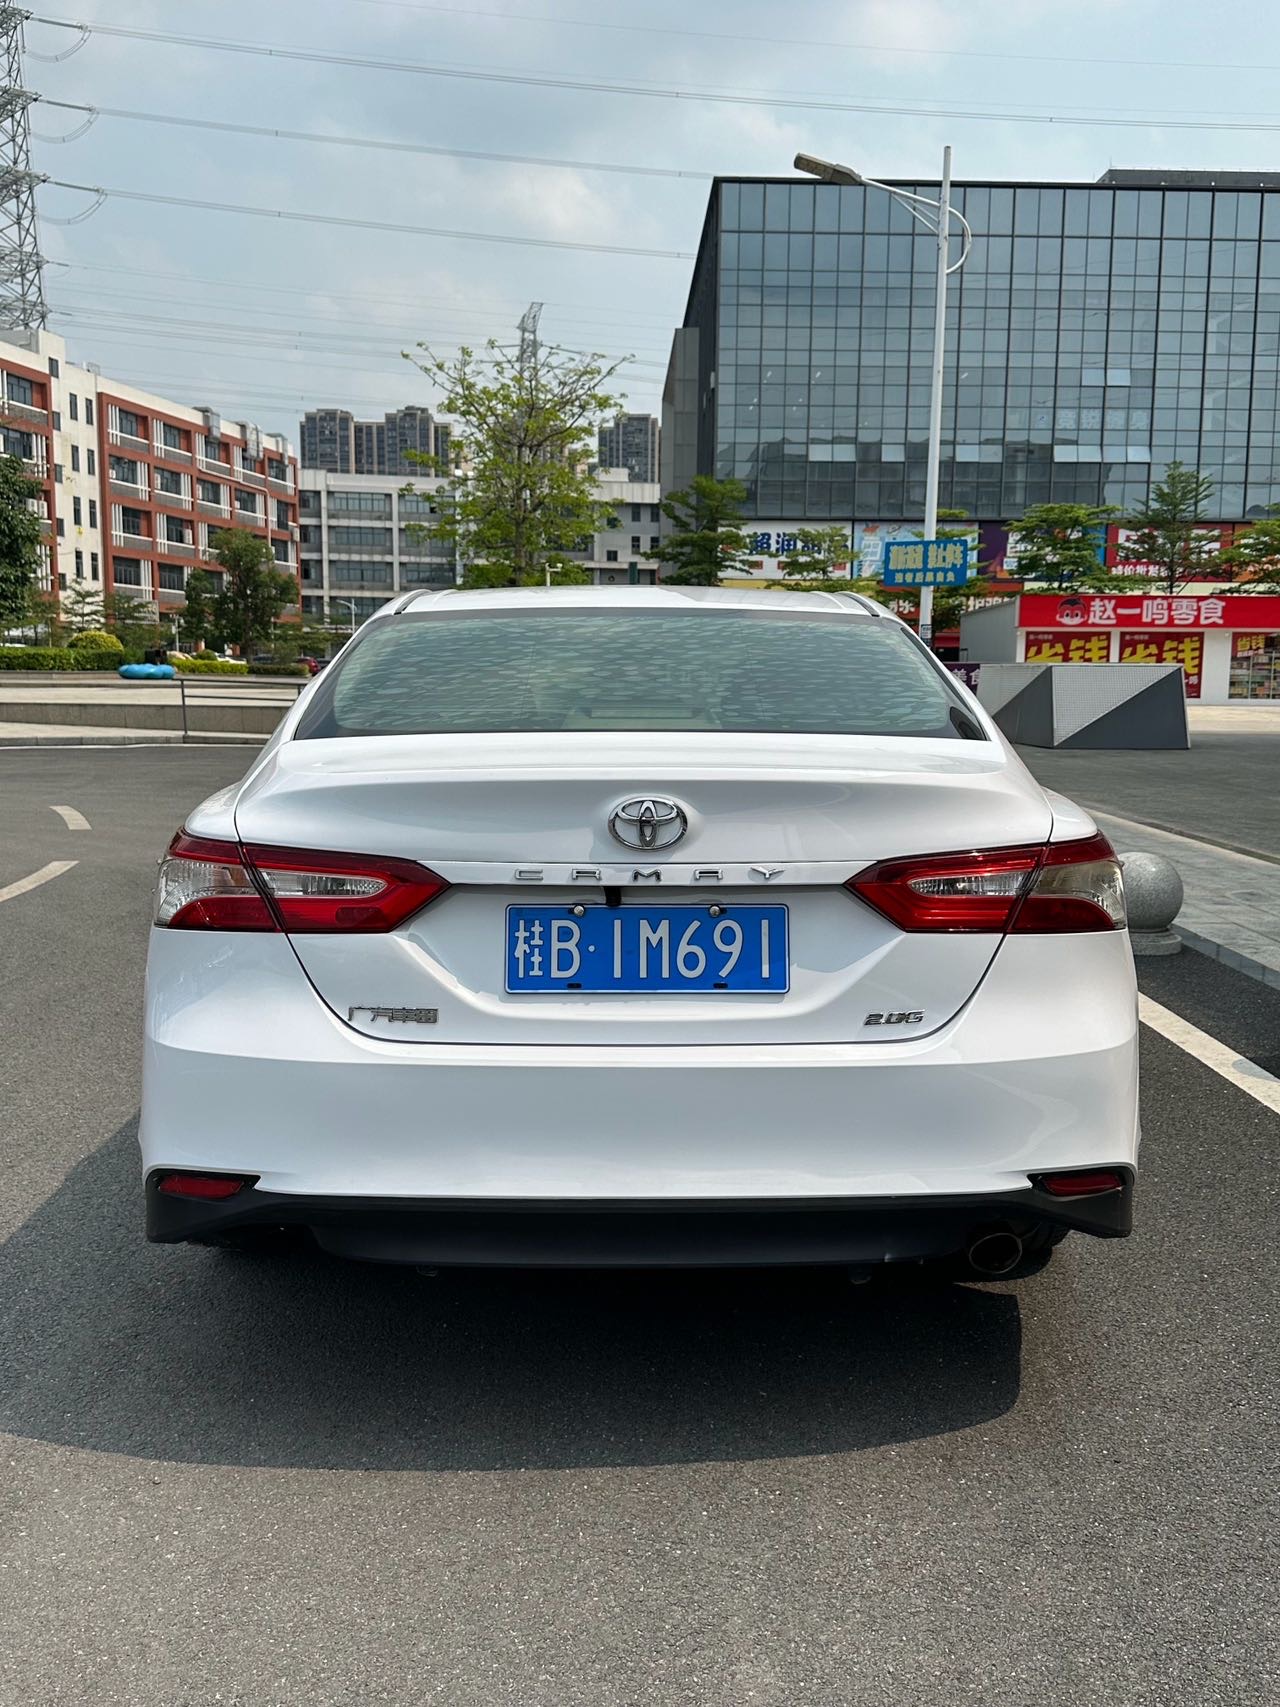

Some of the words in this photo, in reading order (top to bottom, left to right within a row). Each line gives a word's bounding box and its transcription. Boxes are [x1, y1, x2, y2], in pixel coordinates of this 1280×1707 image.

[1088, 598, 1226, 625] 赵一鸣零食
[514, 919, 770, 979] 桂B·1M691
